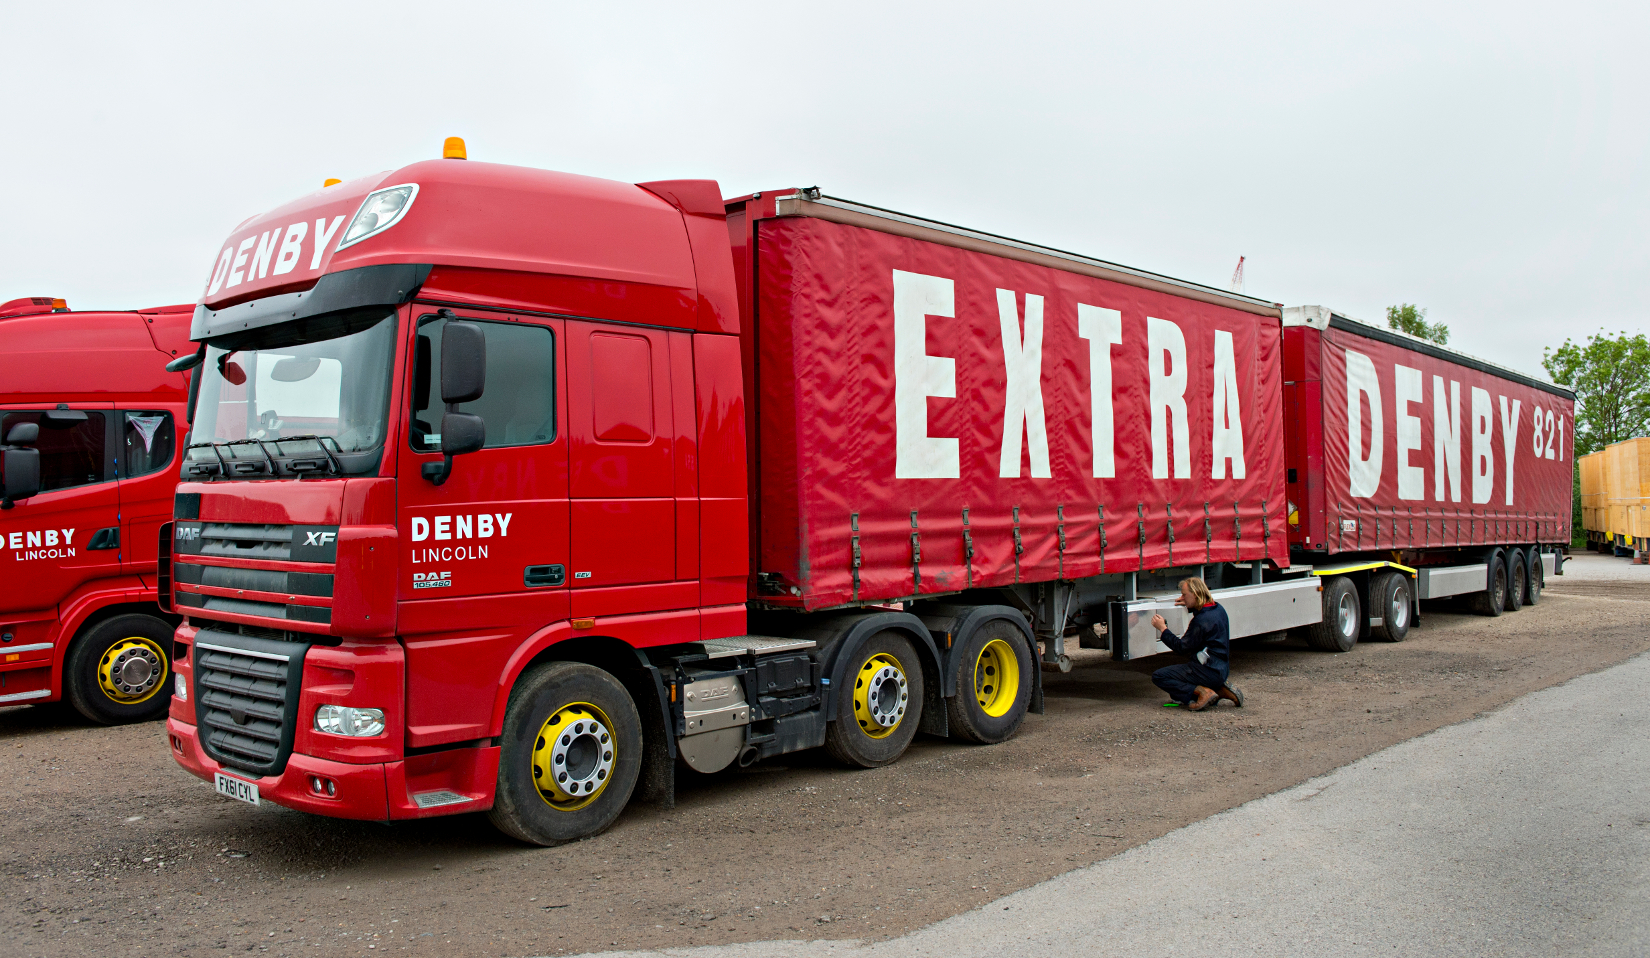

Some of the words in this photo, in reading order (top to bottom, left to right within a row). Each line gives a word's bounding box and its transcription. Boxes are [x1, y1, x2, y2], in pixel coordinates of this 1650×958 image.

[206, 214, 347, 297] DENBY
[892, 268, 1246, 480] EXTRA
[1345, 348, 1521, 506] DENBY
[1533, 405, 1564, 462] 821
[175, 527, 201, 541] DAF
[411, 512, 513, 542] DENBY
[302, 531, 337, 546] XF
[16, 547, 76, 561] LINCOLN
[412, 545, 489, 564] LINCOLN
[413, 571, 452, 581] DAF
[700, 686, 729, 698] DAF
[218, 775, 238, 797] FX61
[238, 782, 255, 803] CYL
